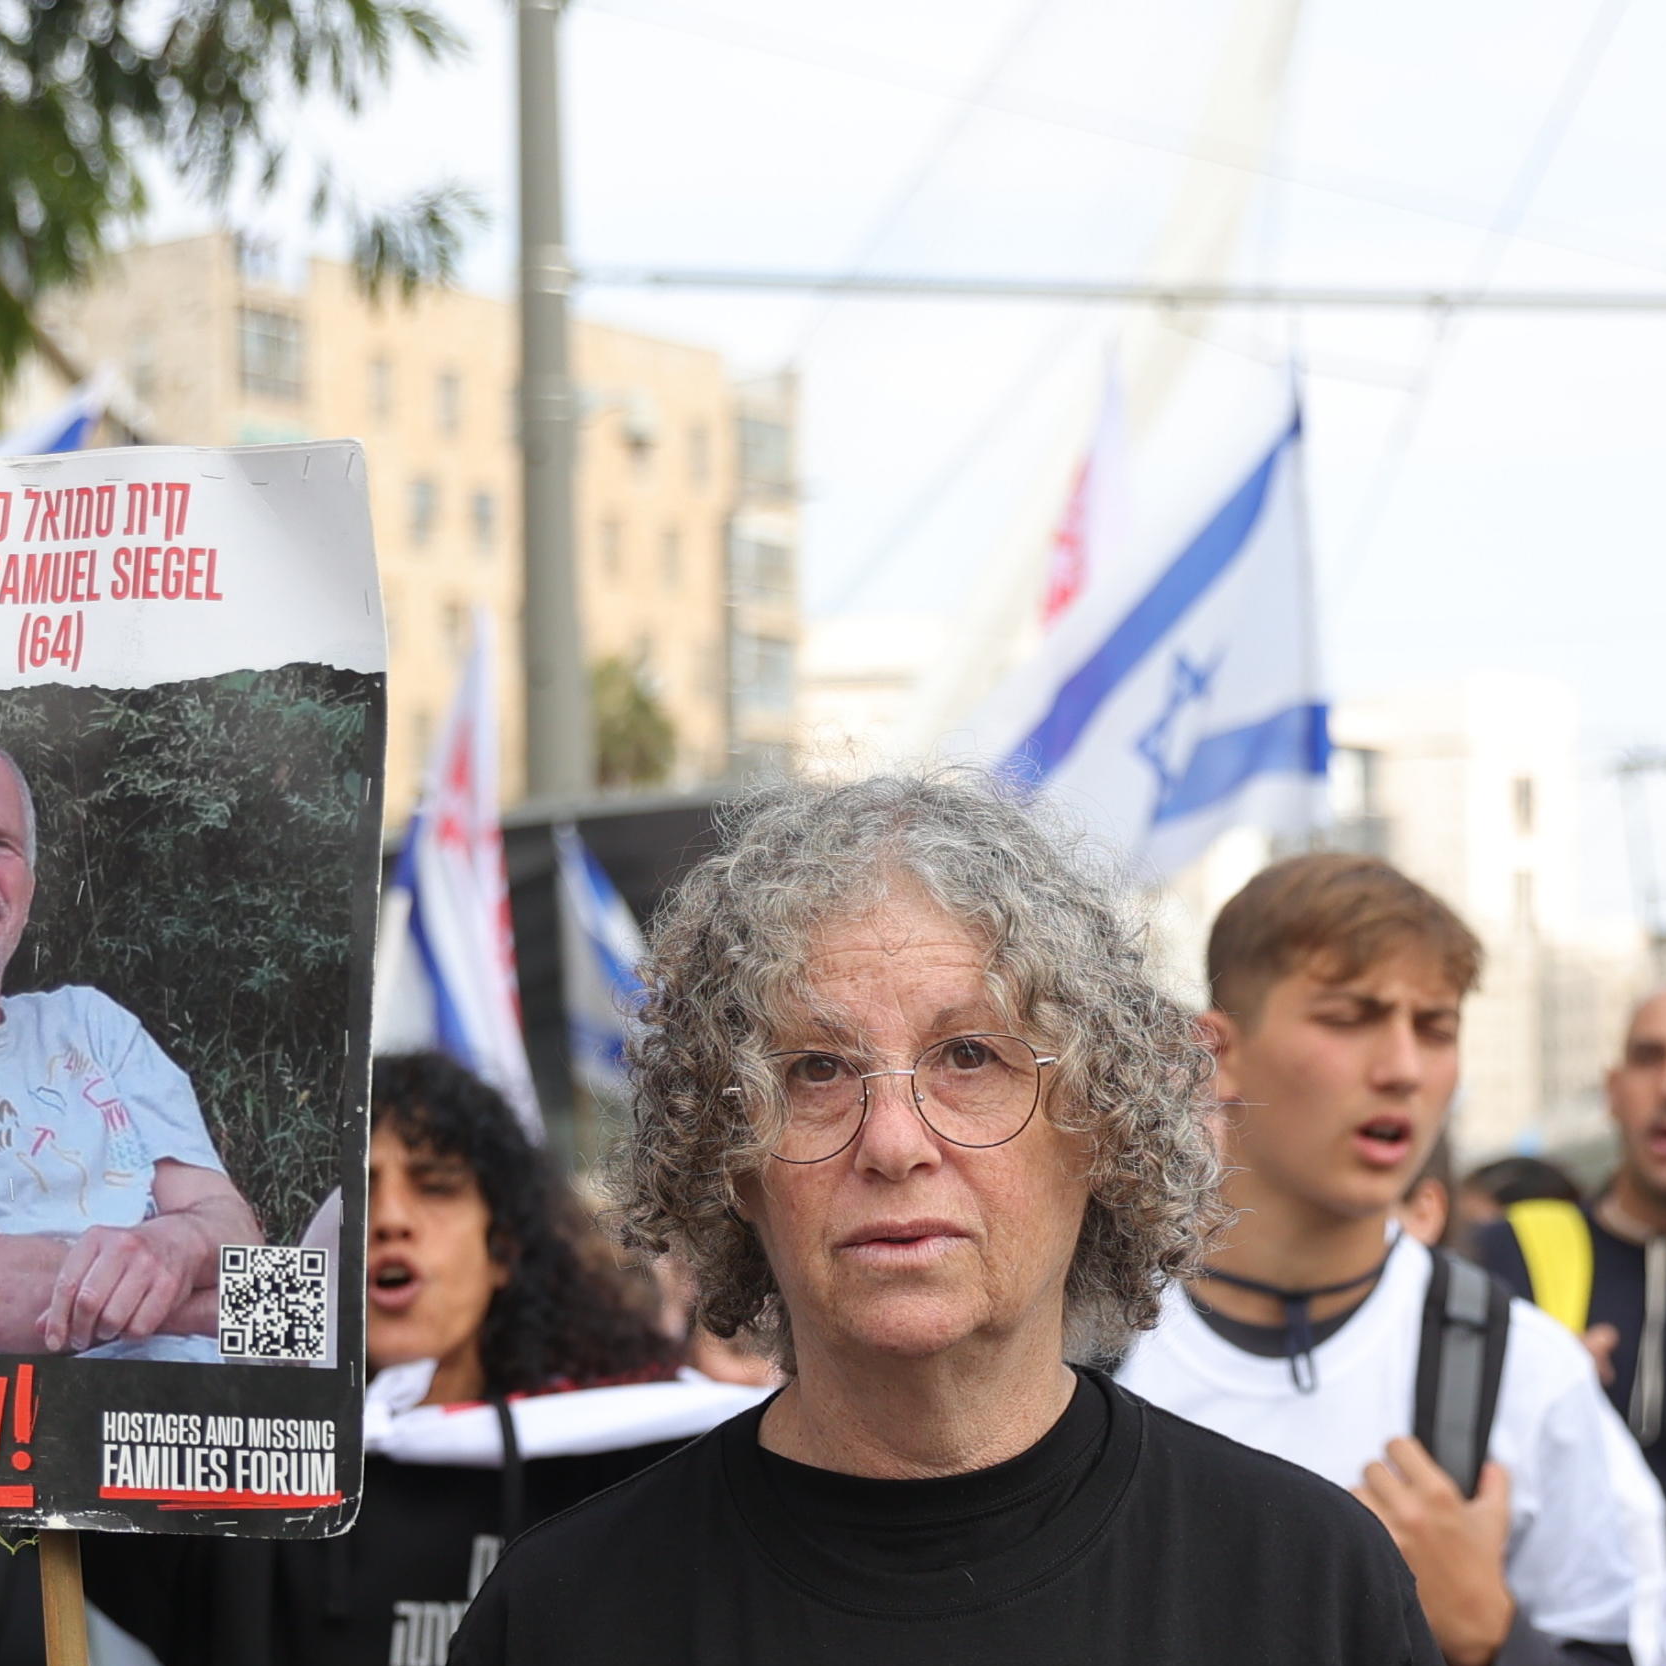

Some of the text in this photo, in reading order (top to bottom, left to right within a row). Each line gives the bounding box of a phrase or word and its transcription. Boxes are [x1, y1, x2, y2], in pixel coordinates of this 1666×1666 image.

[24, 484, 116, 540] סמואל
[123, 481, 191, 542] קית
[111, 546, 223, 602] SIEGEL
[18, 610, 84, 673] (64)
[103, 1411, 336, 1450] HOSTAGES AND MISSING
[102, 1444, 336, 1496] FAMILIES FORUM
